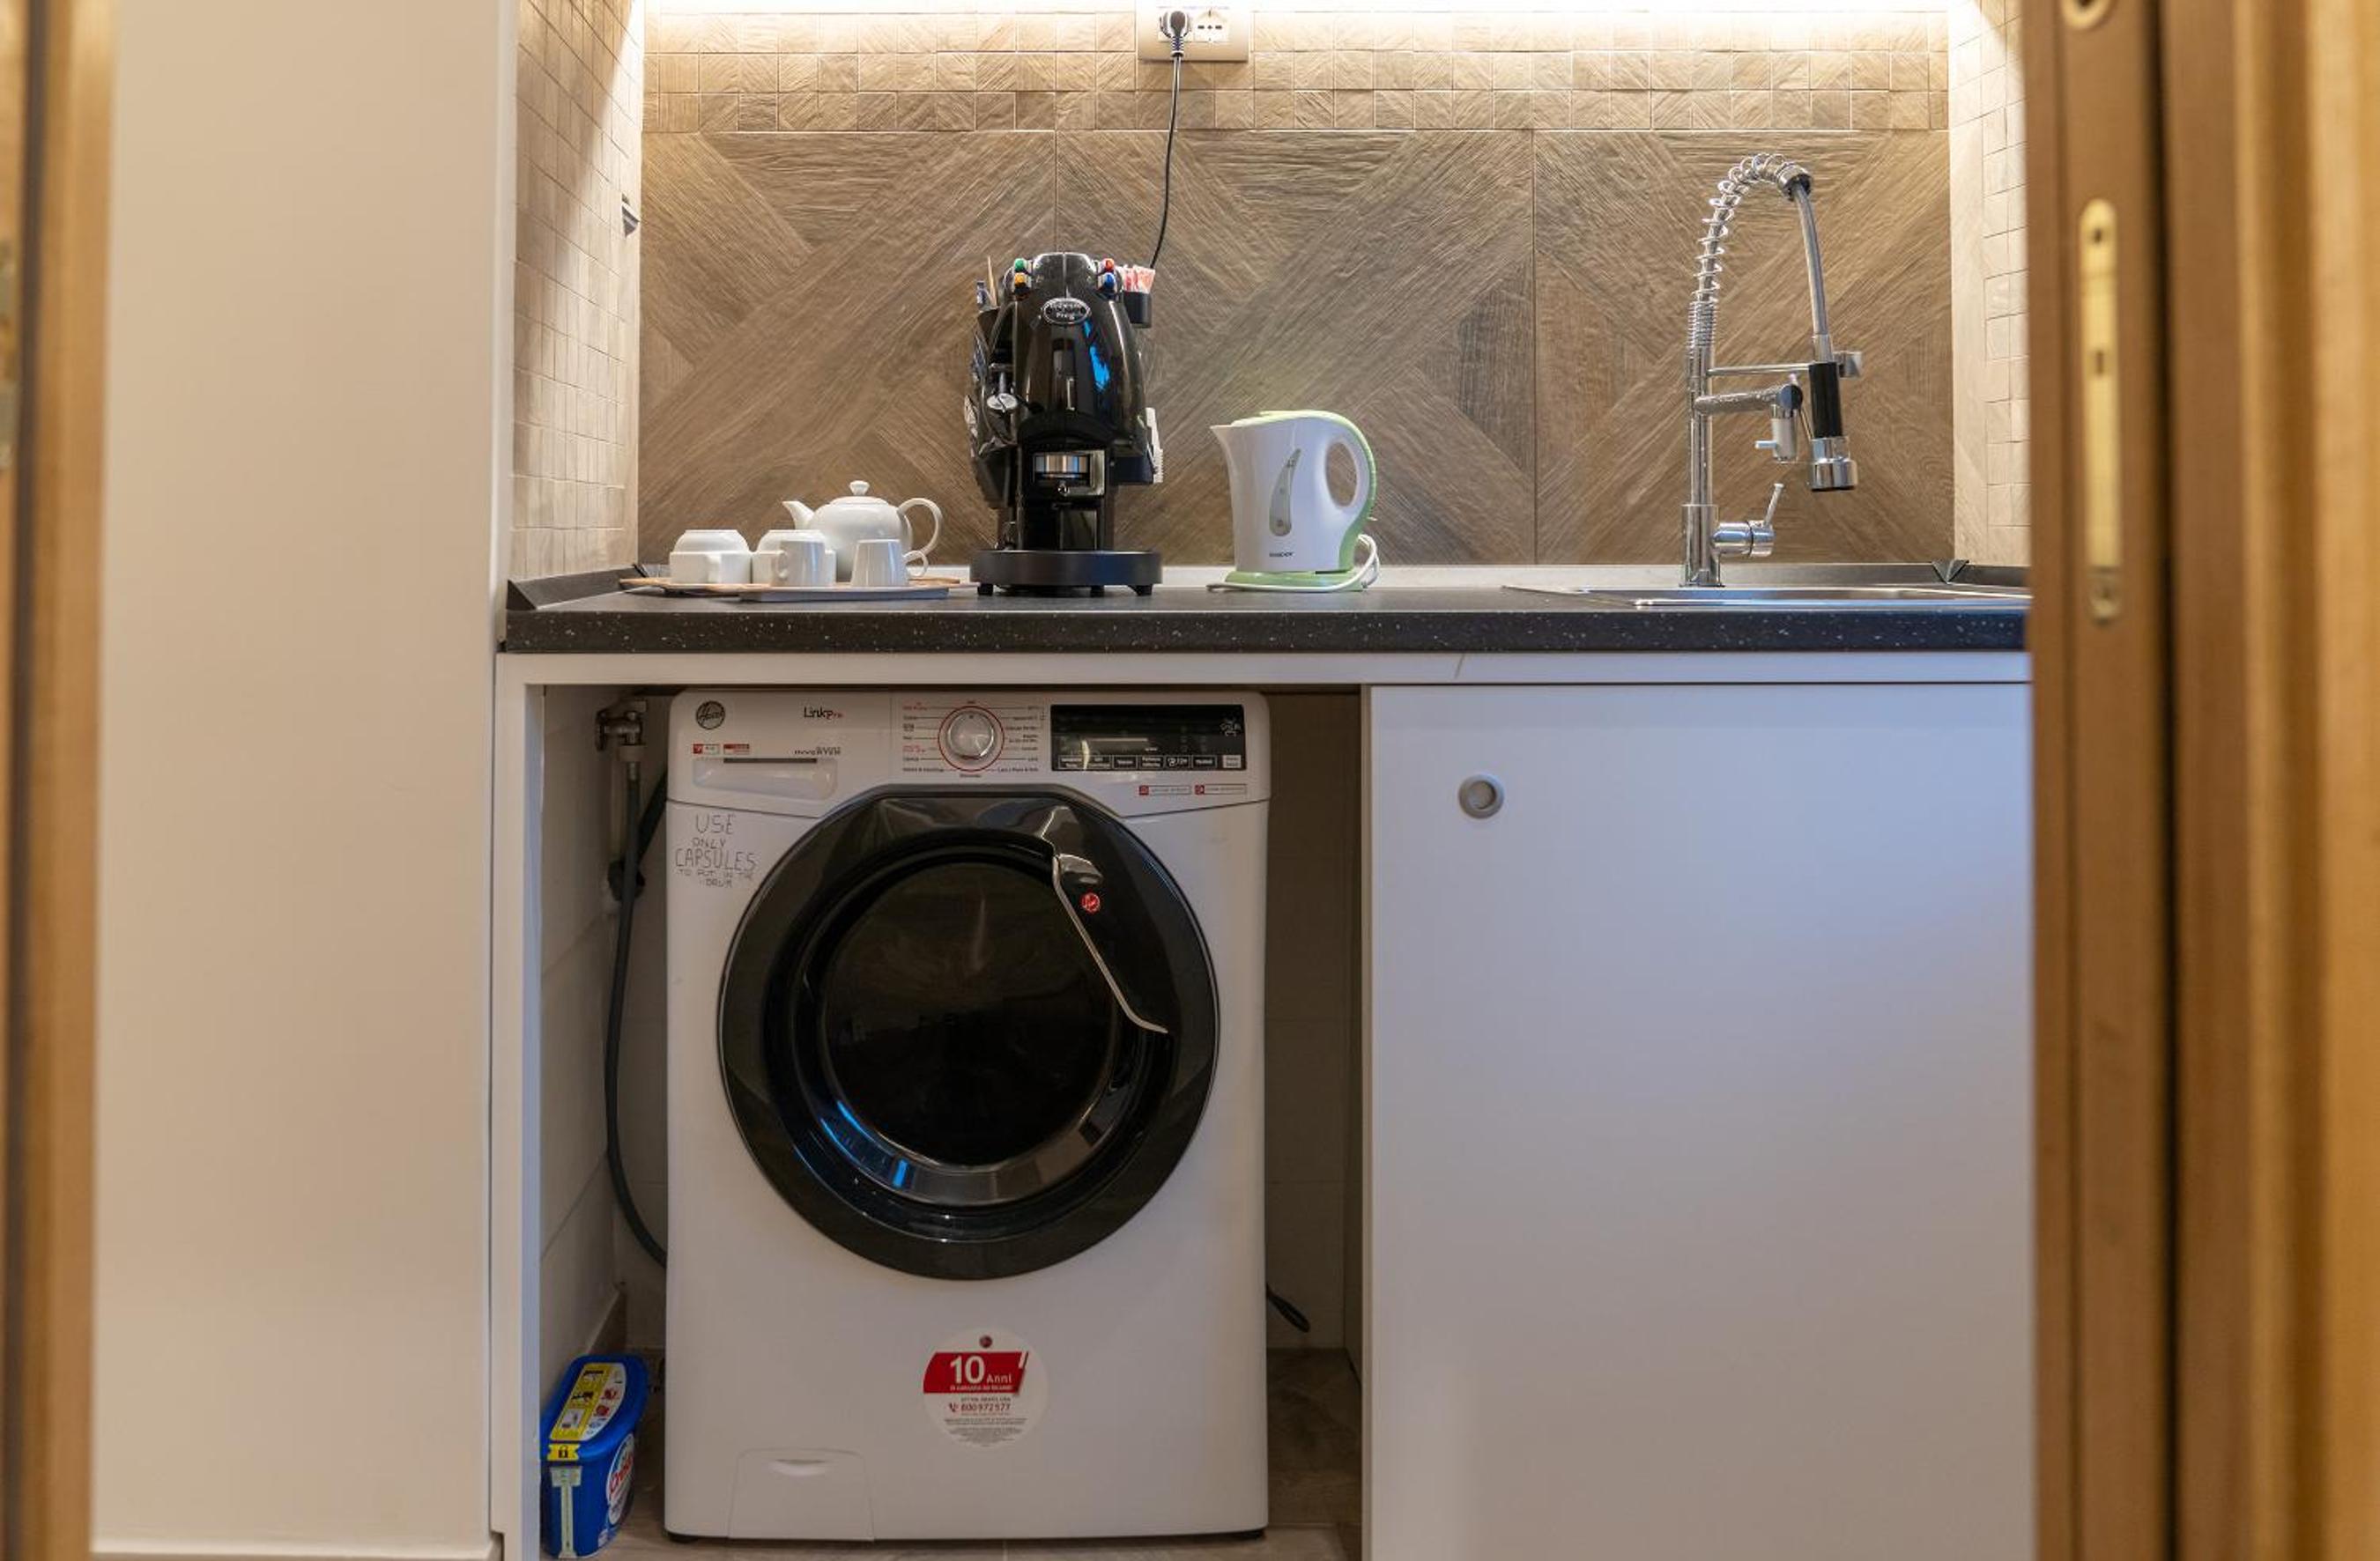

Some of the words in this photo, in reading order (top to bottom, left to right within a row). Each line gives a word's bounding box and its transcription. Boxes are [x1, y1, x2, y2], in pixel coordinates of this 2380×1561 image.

[695, 813, 737, 834] USE
[692, 837, 727, 848] ONLY
[675, 847, 757, 872] CAPSULES
[950, 1355, 986, 1384] 10
[987, 1373, 1012, 1384] Anni
